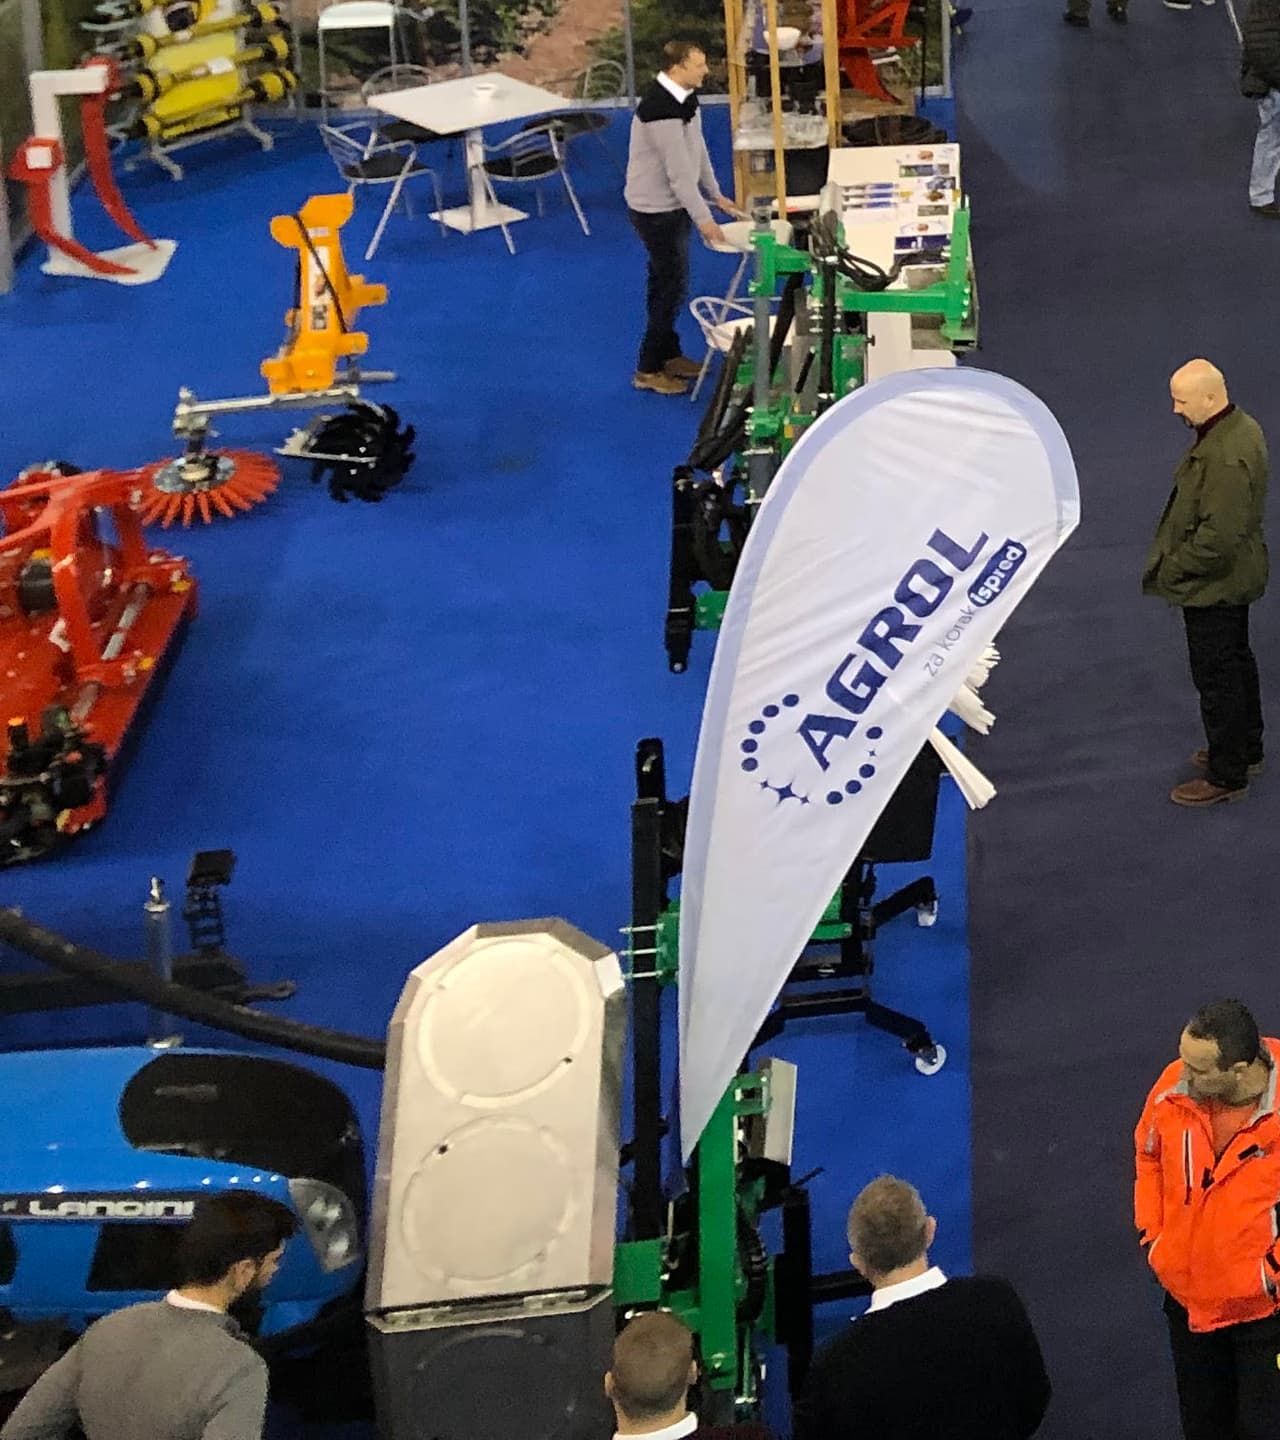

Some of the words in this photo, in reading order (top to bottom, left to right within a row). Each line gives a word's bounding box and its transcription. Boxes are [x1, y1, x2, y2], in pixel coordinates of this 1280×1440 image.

[796, 527, 990, 772] AGROL
[923, 651, 944, 677] za
[941, 604, 978, 652] korak
[29, 1200, 195, 1217] LANDINI
